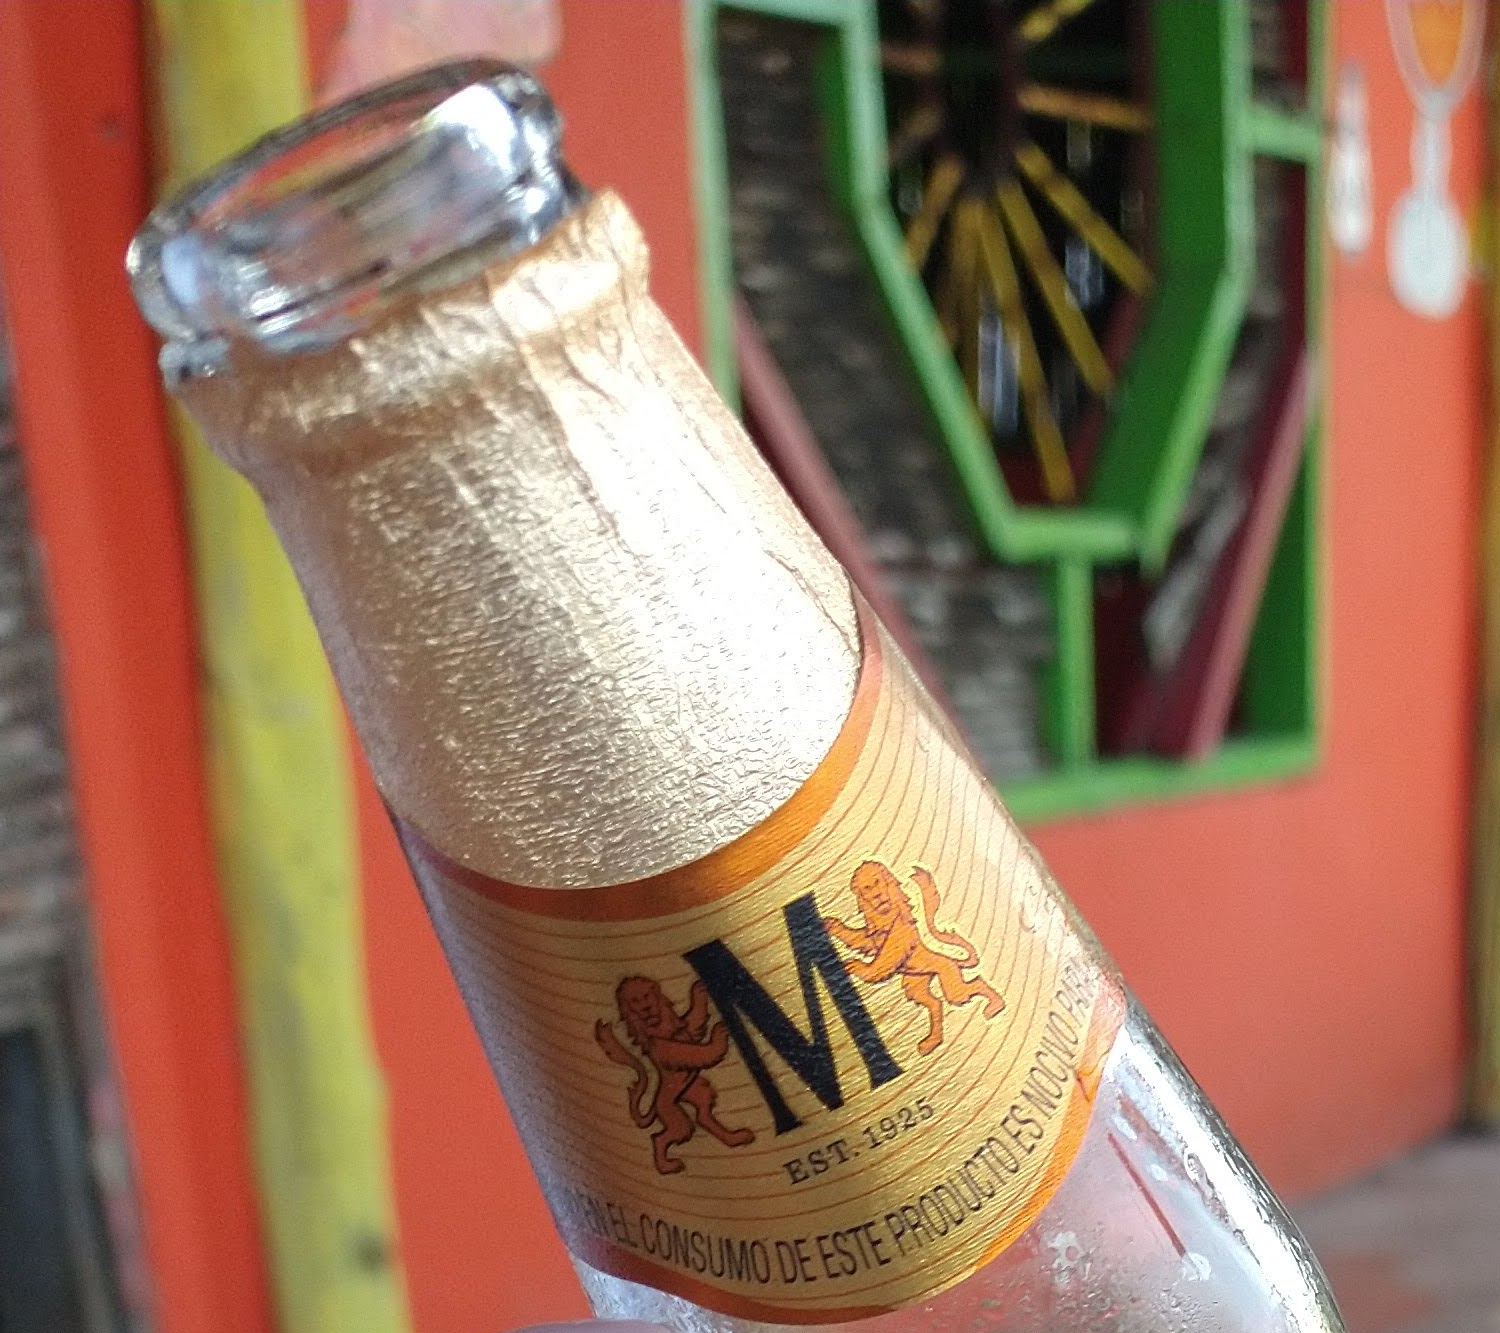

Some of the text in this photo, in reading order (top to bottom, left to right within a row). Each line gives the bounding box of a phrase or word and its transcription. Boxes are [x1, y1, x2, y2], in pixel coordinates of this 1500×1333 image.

[681, 890, 906, 1136] M
[1021, 1011, 1079, 1119] NOCIVO
[782, 1096, 935, 1185] EST. 1925
[1001, 1104, 1044, 1155] ES
[883, 1136, 1019, 1257] PRODUCTO
[639, 1213, 771, 1285] CONSUMO
[774, 1239, 818, 1285] DE
[816, 1221, 892, 1279] ESTE
